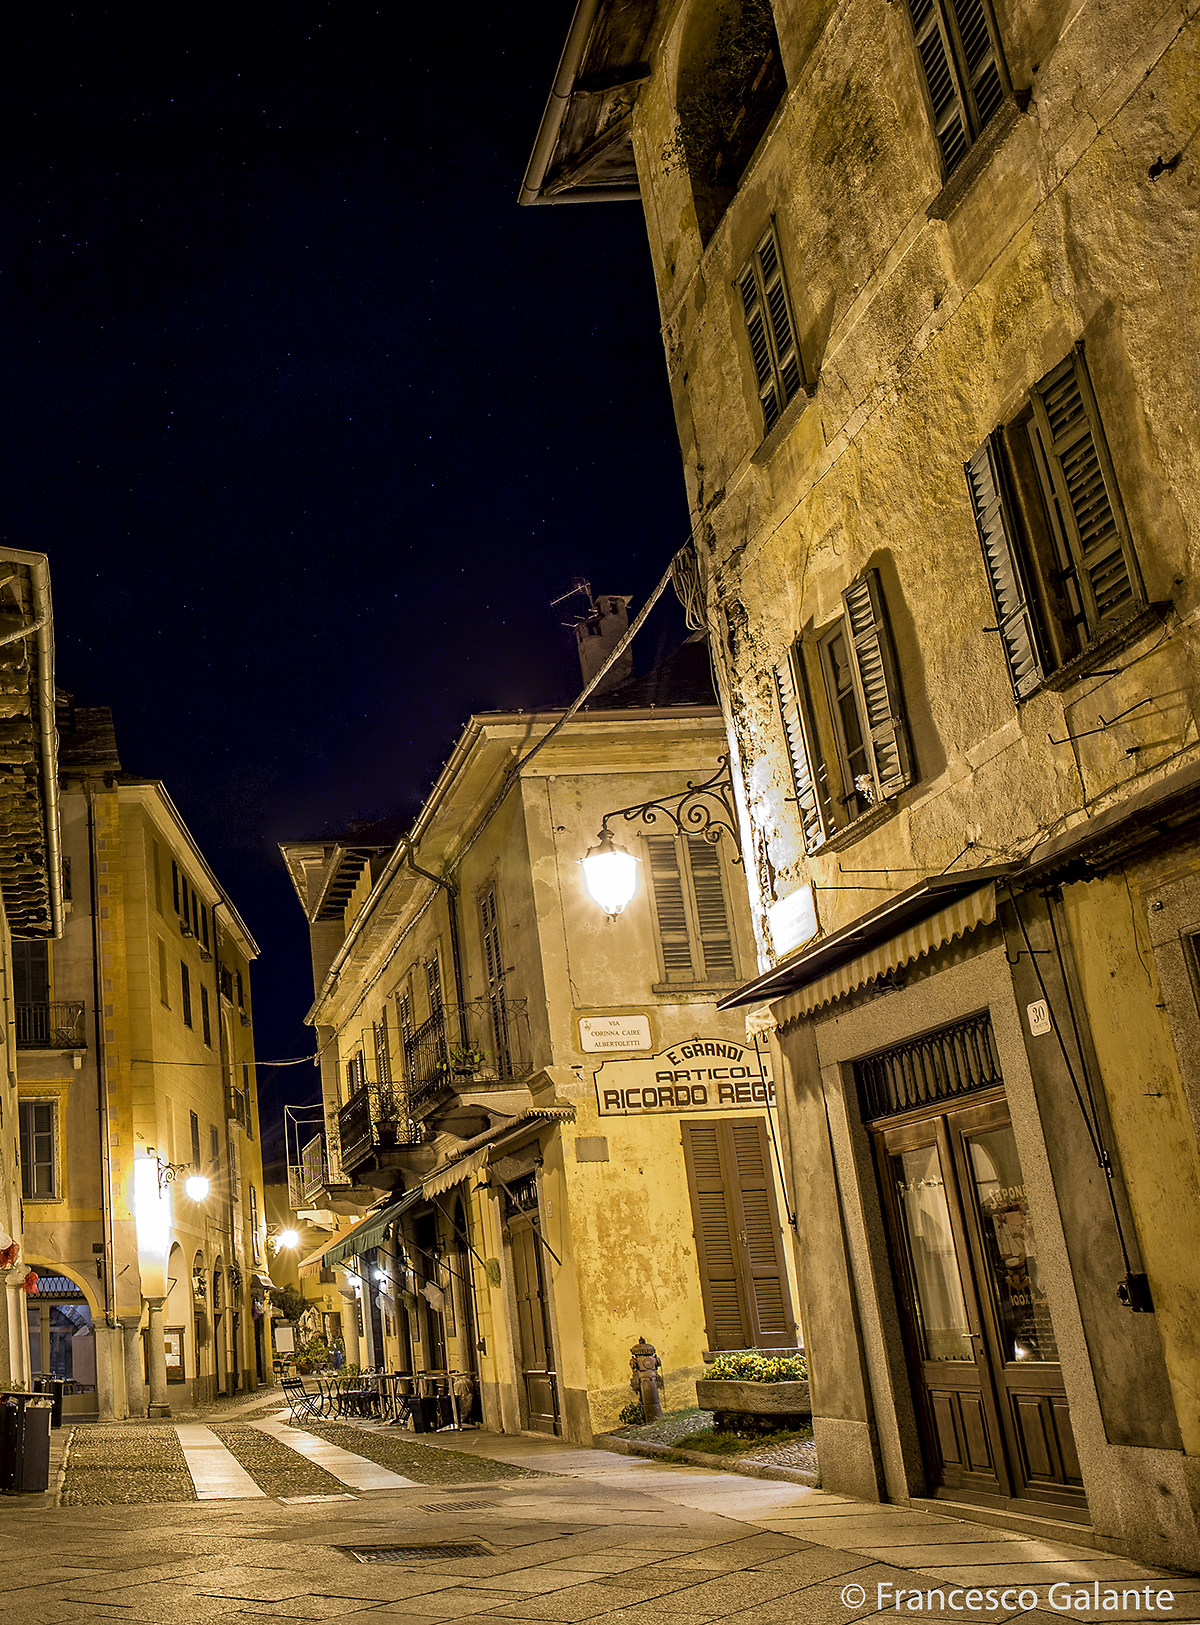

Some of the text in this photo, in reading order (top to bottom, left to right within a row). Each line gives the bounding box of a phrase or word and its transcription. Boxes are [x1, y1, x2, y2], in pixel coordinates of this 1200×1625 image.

[1032, 1006, 1045, 1023] 30
[594, 1040, 641, 1048] ALBERTOLETTI
[655, 1066, 768, 1083] ARTICOLI
[603, 1085, 707, 1109] RICORDO
